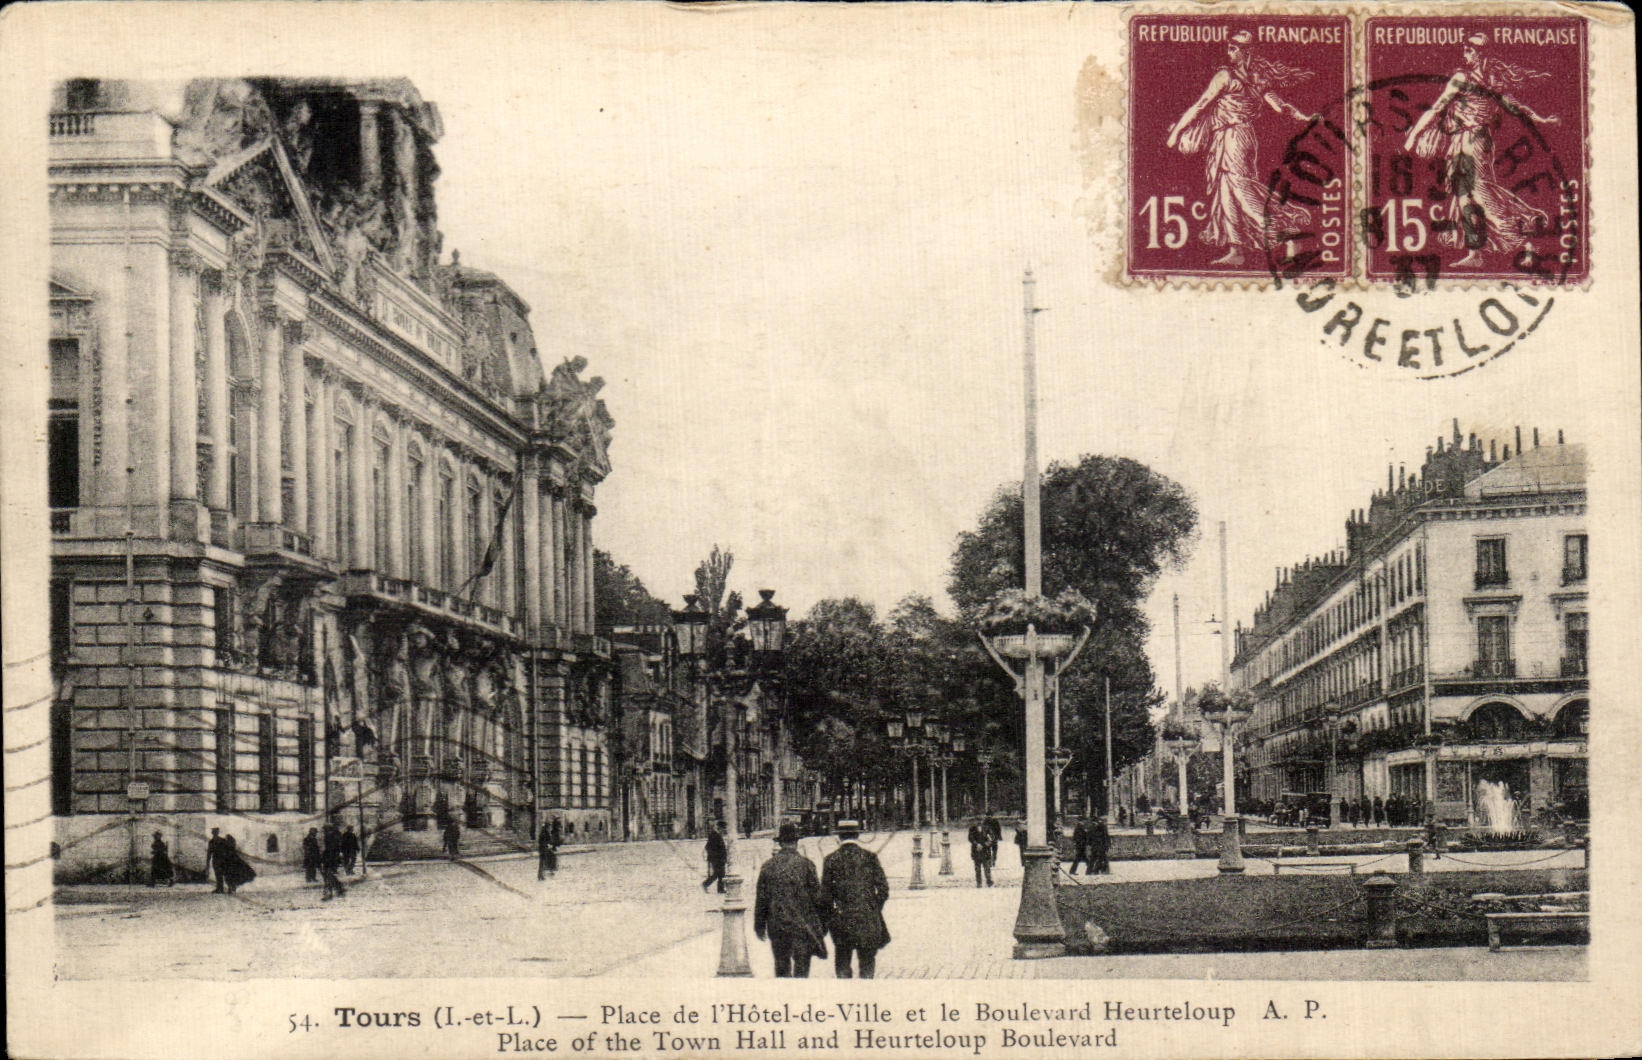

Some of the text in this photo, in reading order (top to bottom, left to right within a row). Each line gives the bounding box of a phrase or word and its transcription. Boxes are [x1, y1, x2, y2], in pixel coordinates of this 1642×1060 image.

[1257, 25, 1342, 45] FRANÇAISE
[1493, 27, 1578, 47] FRANÇAISE
[1321, 177, 1343, 263] POSTES
[1559, 179, 1579, 264] POSTES
